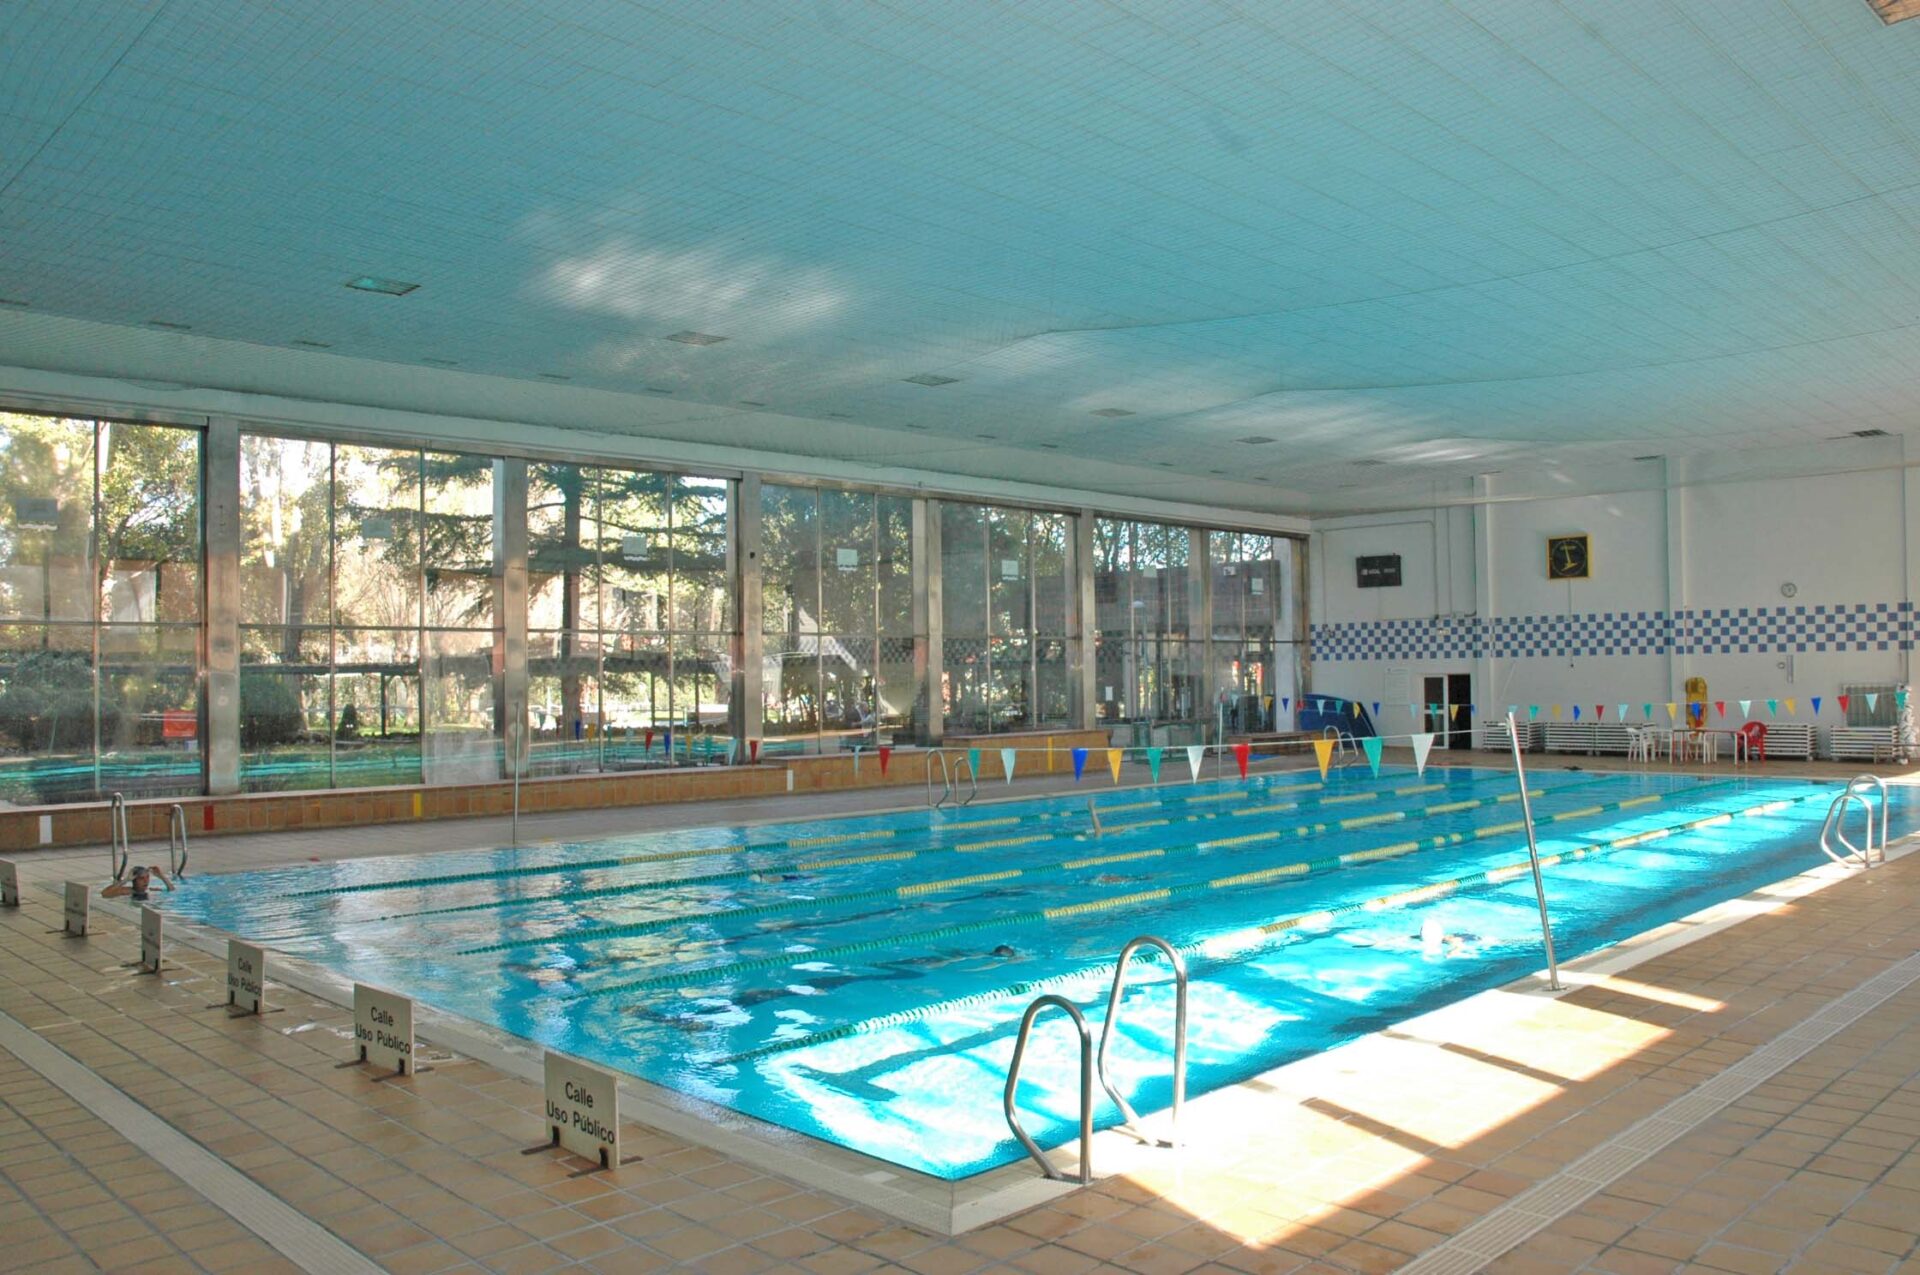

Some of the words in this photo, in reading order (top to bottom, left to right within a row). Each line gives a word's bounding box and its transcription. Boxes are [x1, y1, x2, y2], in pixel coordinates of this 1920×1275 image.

[370, 1006, 394, 1027] Calle
[355, 1023, 373, 1042] Uso
[565, 1081, 594, 1109] Calle
[546, 1099, 568, 1124] Uso
[573, 1110, 615, 1145] Público
